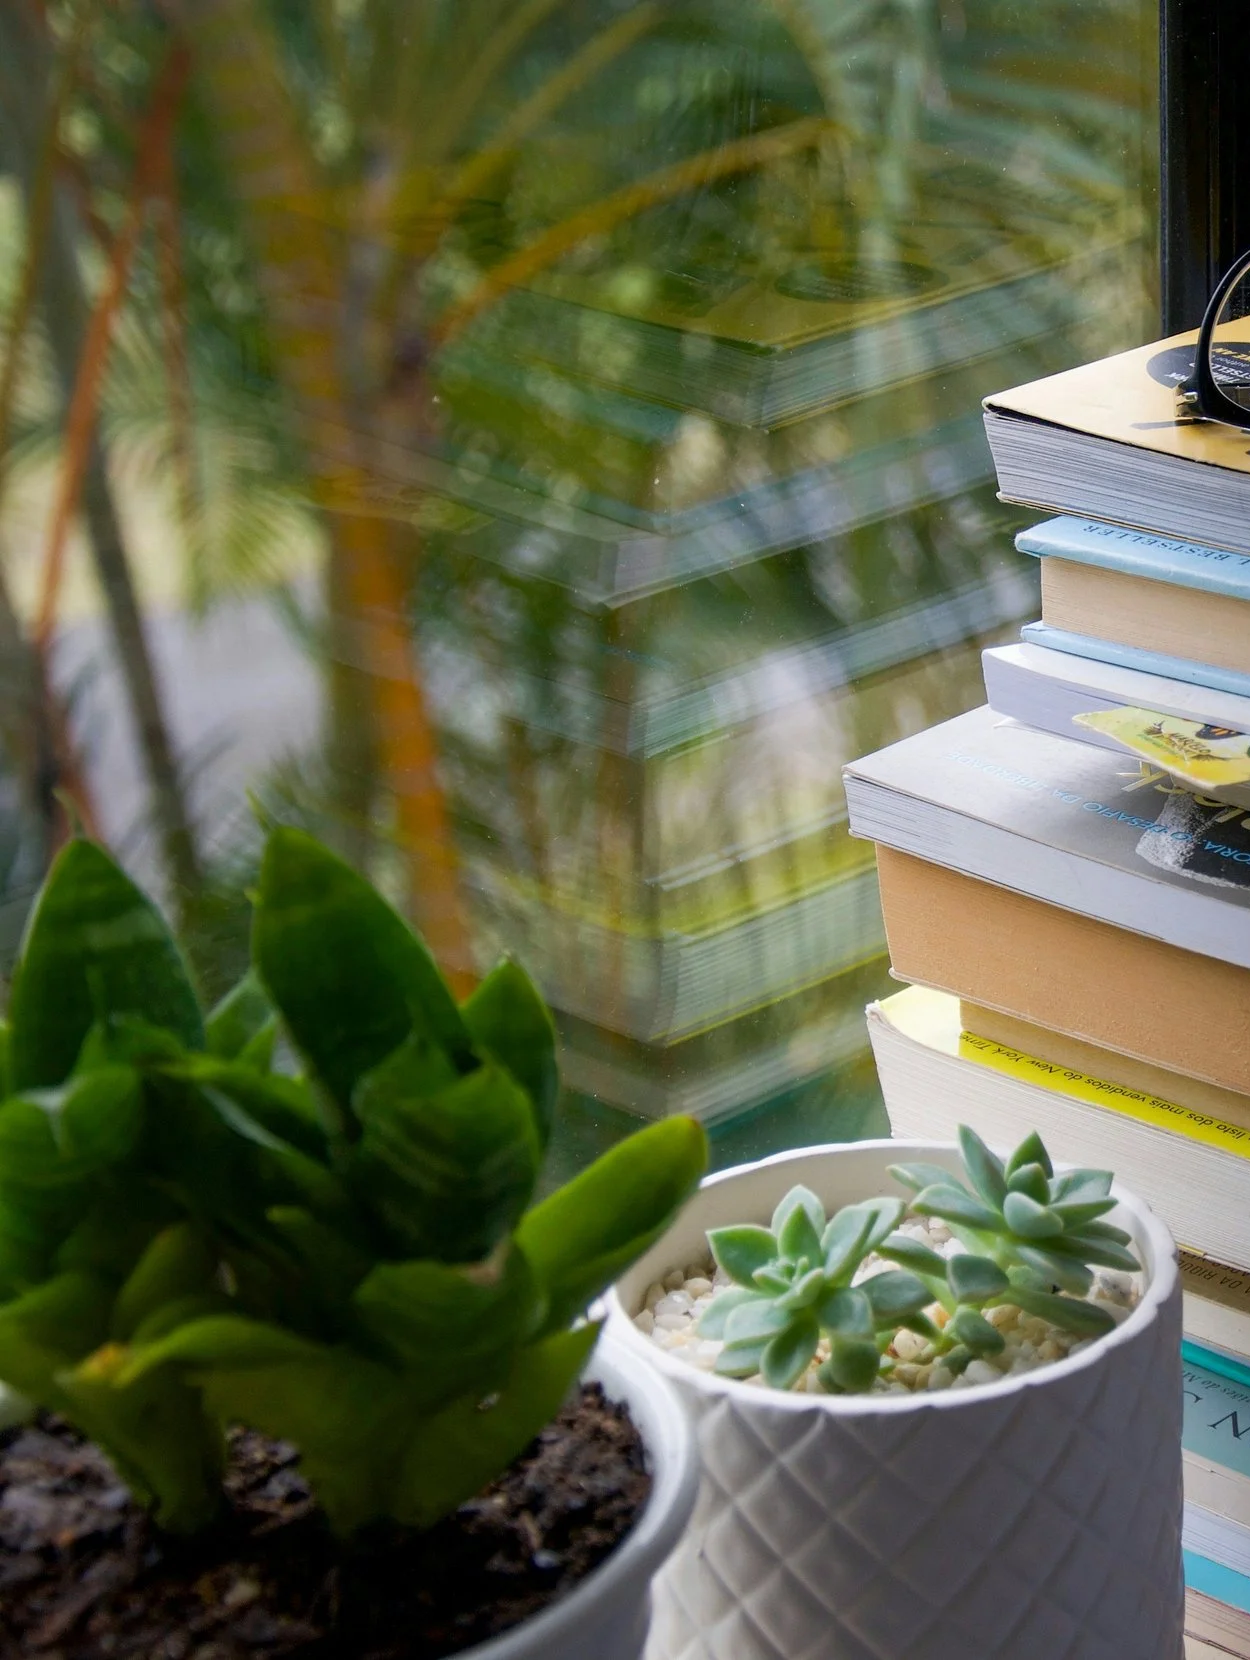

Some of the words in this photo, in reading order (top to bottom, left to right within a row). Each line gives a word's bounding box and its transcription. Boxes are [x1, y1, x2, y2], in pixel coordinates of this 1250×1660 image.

[1081, 525, 1231, 562] BESTSELLER
[1082, 801, 1169, 836] DESAFIO
[991, 1047, 1025, 1063] York
[1026, 1058, 1062, 1075] New
[1062, 1070, 1084, 1084] do
[1084, 1076, 1147, 1105] vendidos
[1148, 1099, 1186, 1117] mais
[1186, 1112, 1215, 1128] dos
[1215, 1123, 1247, 1140] lista
[1218, 1274, 1244, 1291] DA
